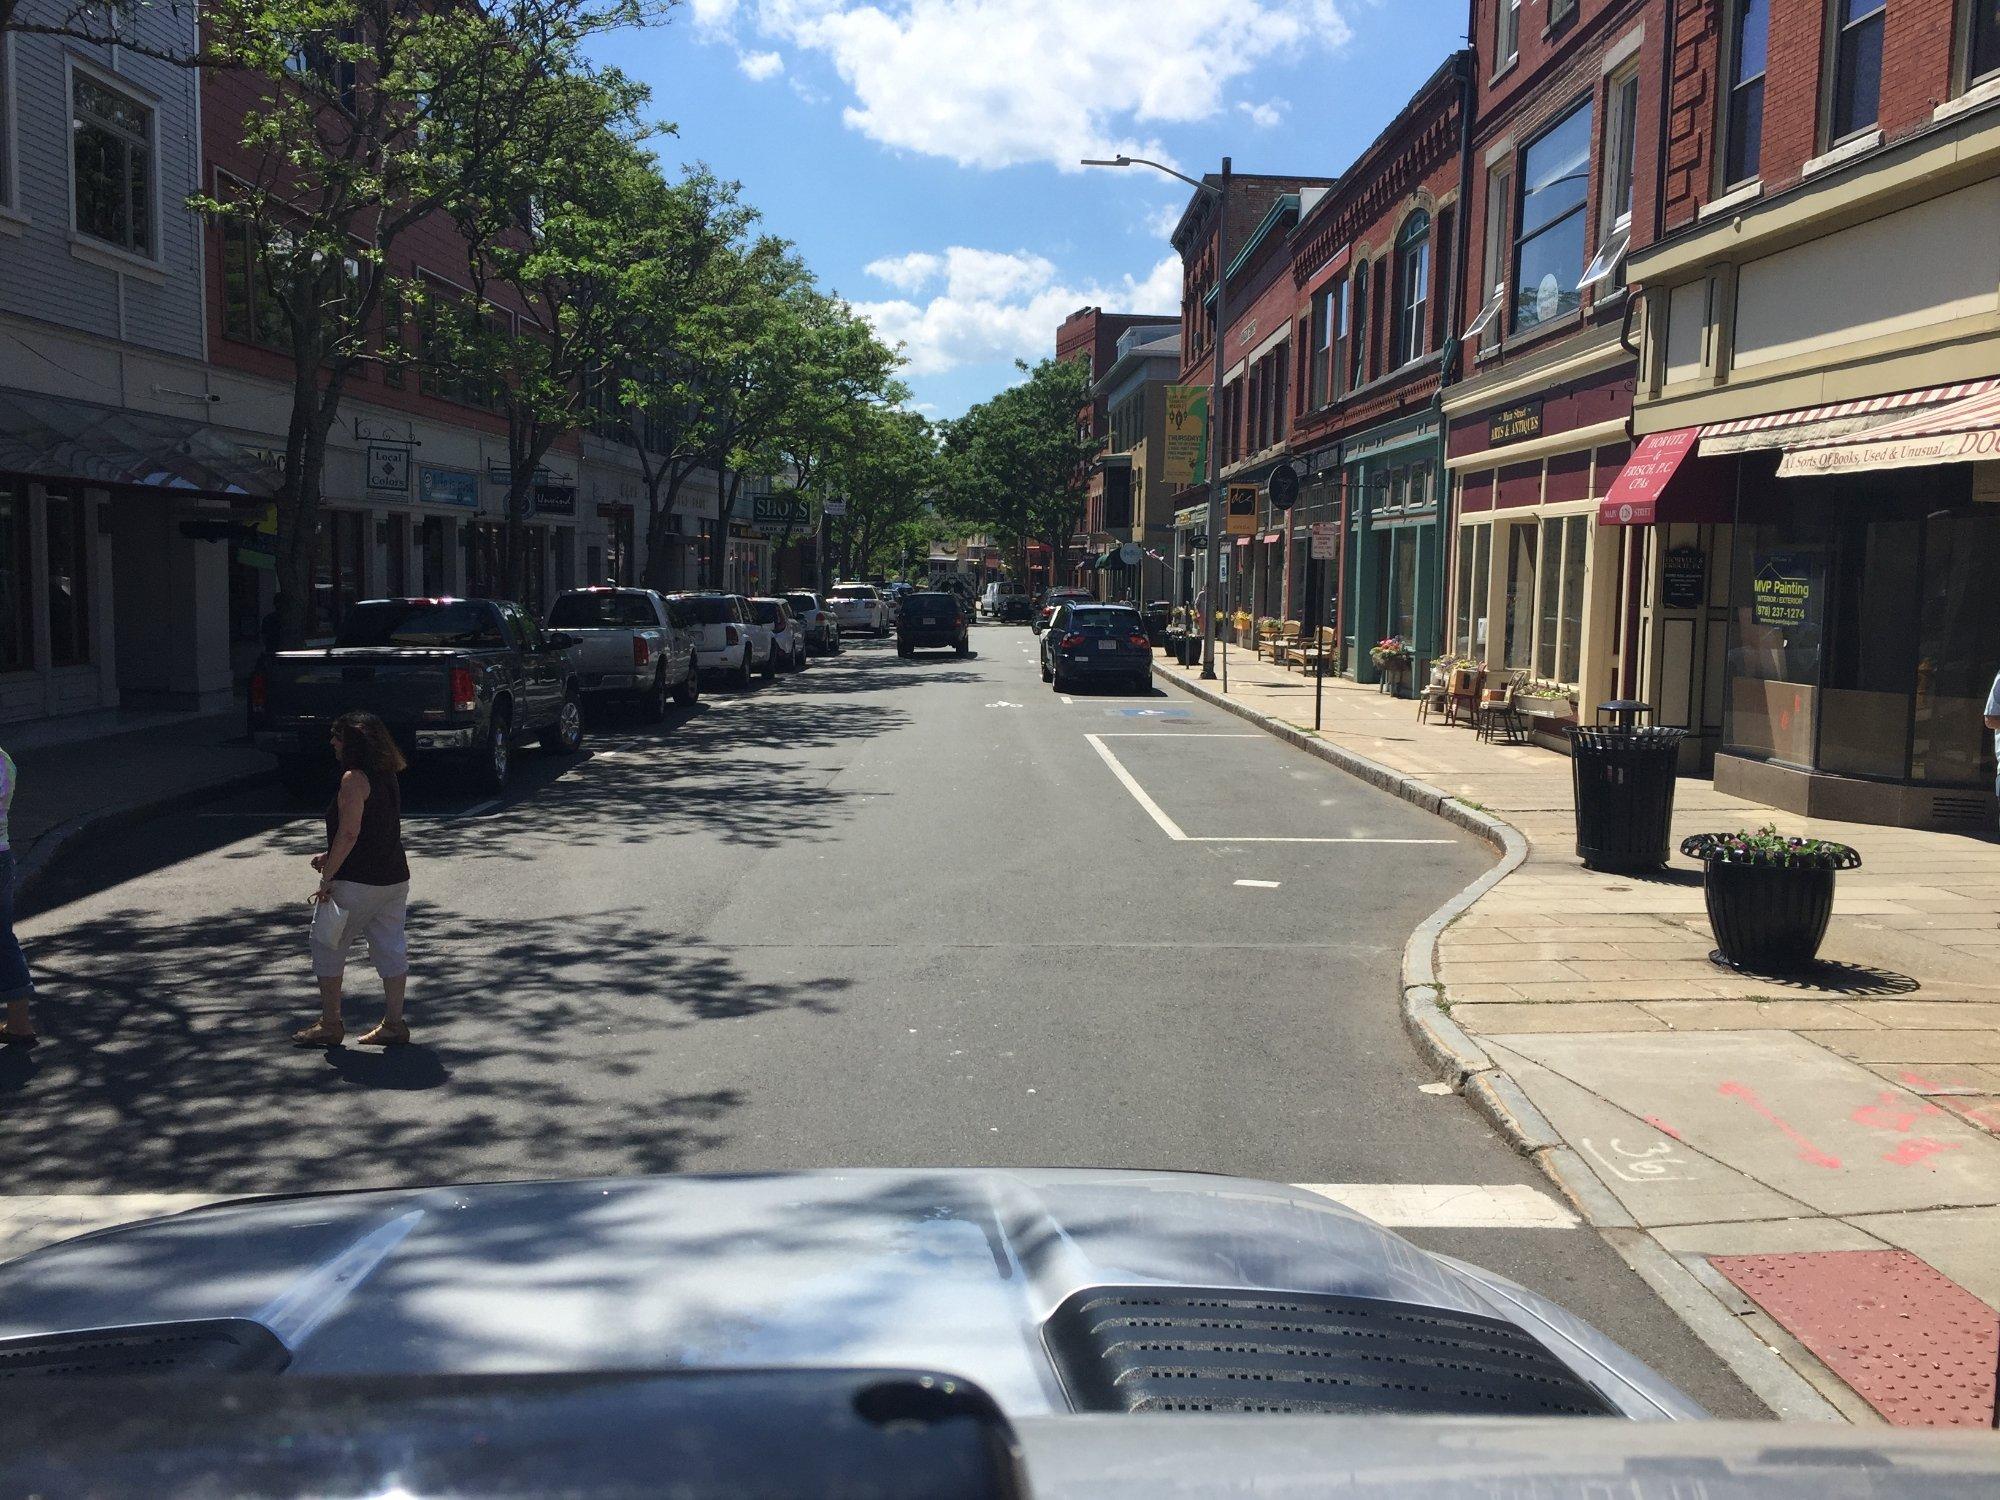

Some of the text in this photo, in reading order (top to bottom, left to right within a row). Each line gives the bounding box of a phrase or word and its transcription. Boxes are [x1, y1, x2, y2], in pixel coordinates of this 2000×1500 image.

[1503, 407, 1526, 422] Main Street
[1491, 416, 1539, 441] ARTS & ANTIQUES
[1647, 433, 1689, 449] HORVITZ
[375, 451, 402, 463] Local
[1653, 449, 1662, 461] &
[1796, 456, 1817, 468] Sorts
[1819, 452, 1834, 466] Of
[1834, 451, 1860, 466] Books,
[1864, 447, 1888, 463] Used
[1889, 447, 1898, 460] &
[1900, 441, 1945, 459] Unusual
[372, 475, 405, 488] Colors
[1628, 478, 1650, 490] CPAs
[537, 494, 572, 505] Unwind
[1604, 509, 1618, 519] MAIN
[1634, 507, 1653, 517] STREET
[1754, 579, 1810, 599] MVP Painting
[1757, 595, 1776, 603] INTERIOR
[1779, 597, 1803, 605] EXTERIOR
[1756, 604, 1805, 619] (978) 237-1274
